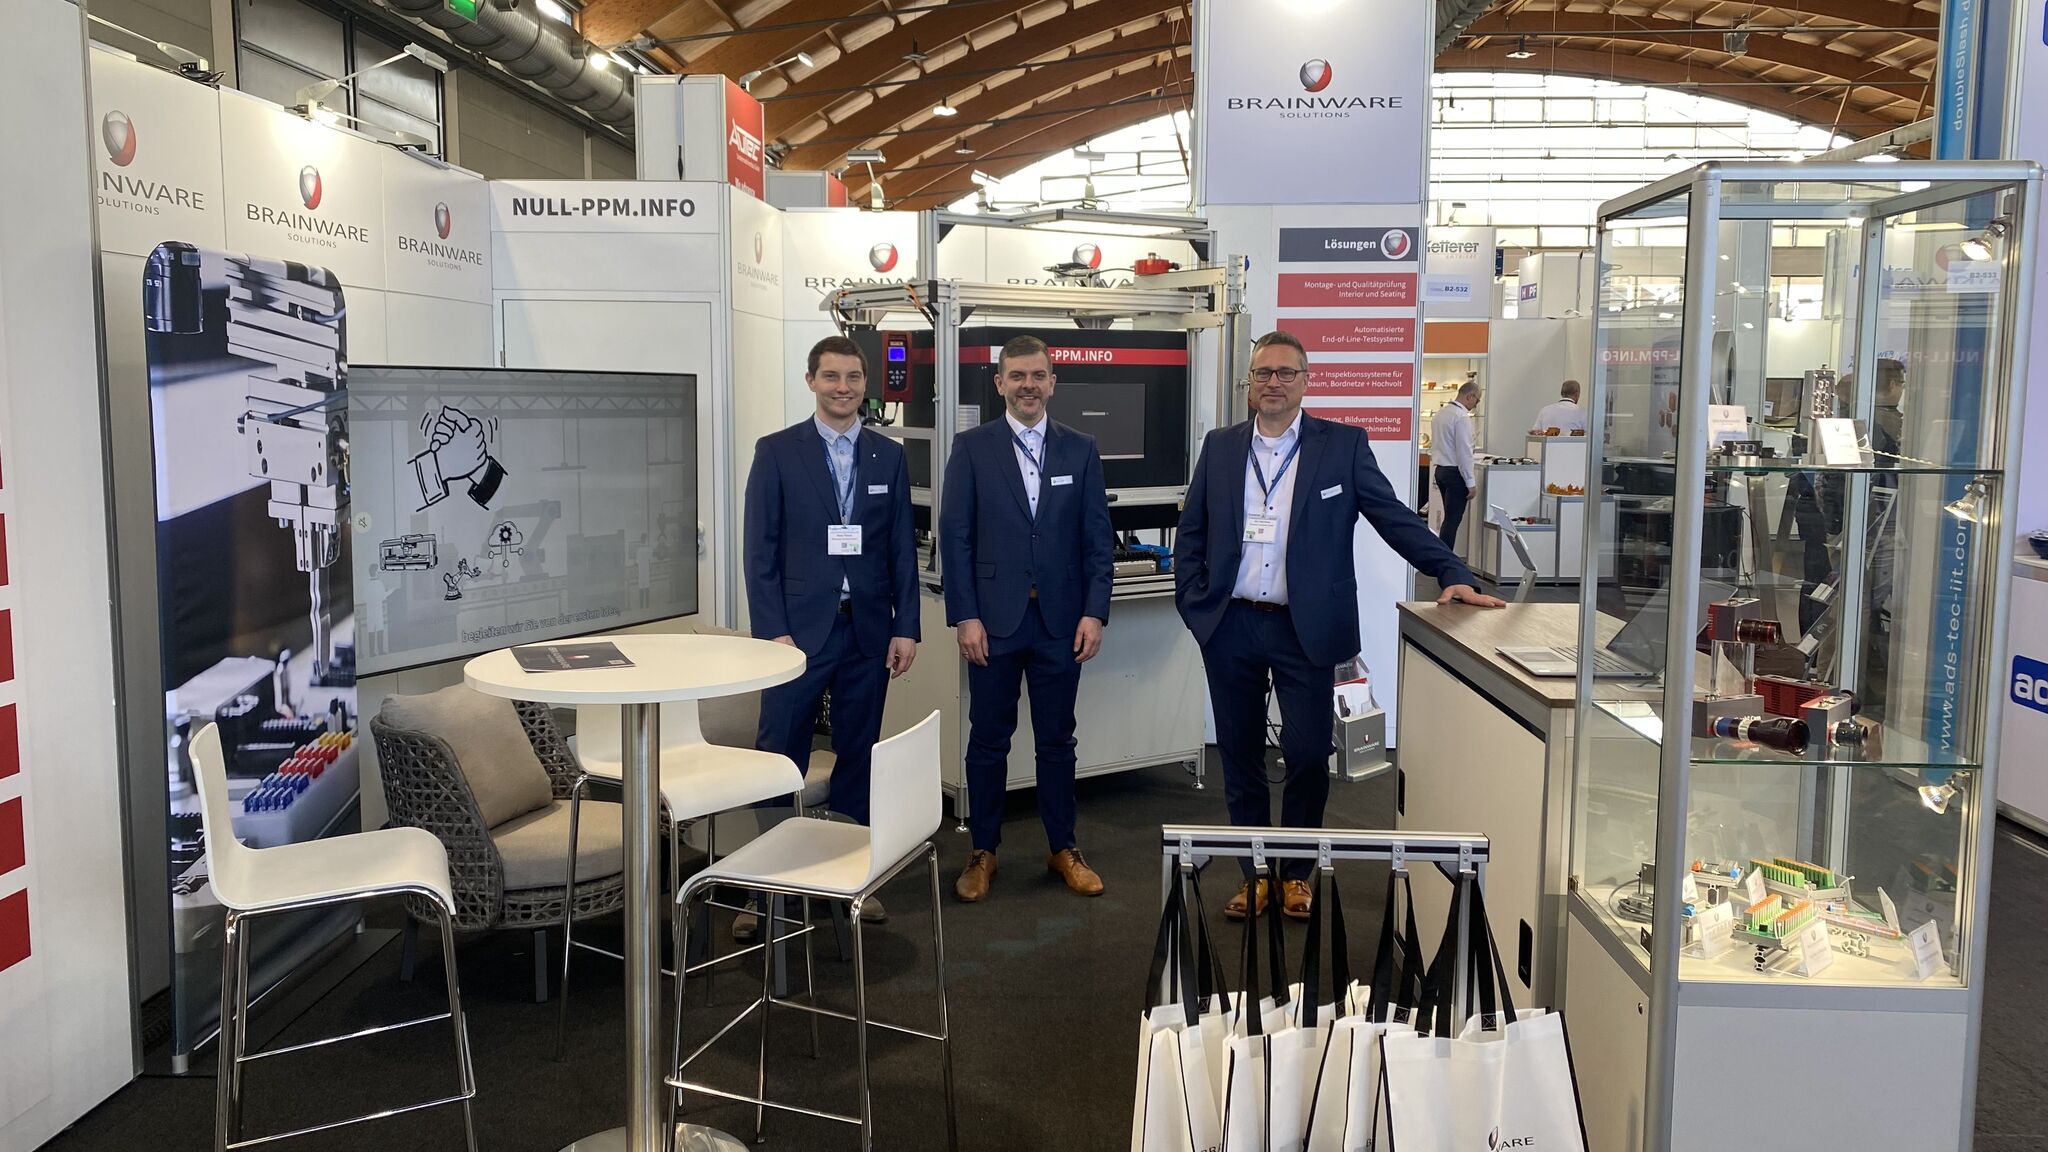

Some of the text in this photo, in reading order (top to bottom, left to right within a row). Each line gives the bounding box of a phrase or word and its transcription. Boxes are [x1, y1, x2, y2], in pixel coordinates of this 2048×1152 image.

[1228, 96, 1403, 110] BRAINWARE
[512, 197, 696, 217] NULL-PPM.INFO
[246, 203, 369, 243] BRAINWARE
[287, 232, 337, 249] SOLUTIONS
[1325, 239, 1377, 251] Lösungen
[398, 235, 483, 266] BRAINWARE
[427, 258, 462, 271] SOLUTIONS
[737, 262, 780, 286] BRAINWARE
[1304, 281, 1337, 290] Montage-
[1351, 281, 1407, 290] Qualitätprüfung
[1380, 291, 1406, 299] Seating
[1321, 335, 1405, 344] End-of-Line-Testsysteme
[1325, 371, 1392, 379] Inspektionssysteme
[1330, 380, 1365, 388] Bordnetze
[1344, 416, 1402, 424] Bildverarbeitung
[461, 626, 507, 643] begleiten
[507, 622, 524, 634] wir
[525, 619, 540, 631] Sie
[540, 616, 557, 629] von
[558, 612, 574, 625] der
[1495, 1136, 1535, 1152] ARE
